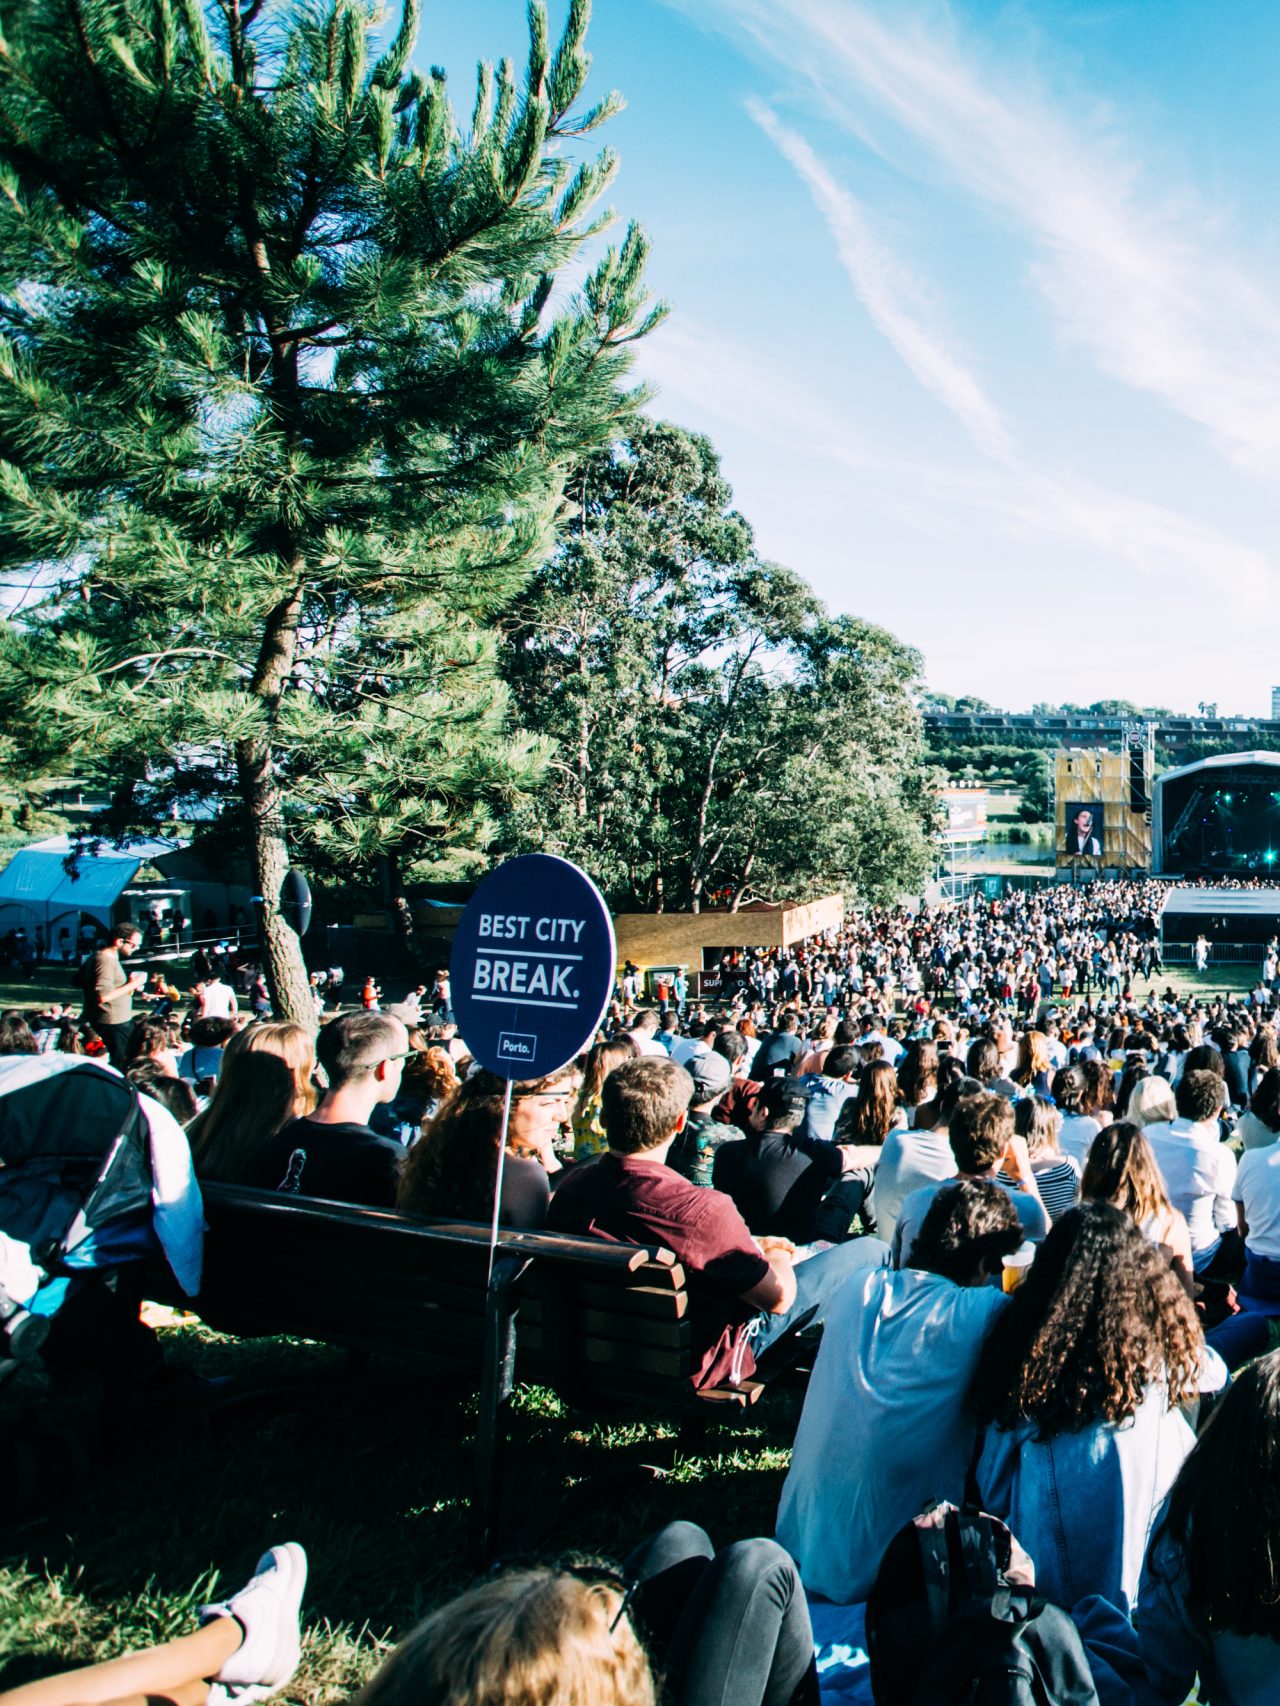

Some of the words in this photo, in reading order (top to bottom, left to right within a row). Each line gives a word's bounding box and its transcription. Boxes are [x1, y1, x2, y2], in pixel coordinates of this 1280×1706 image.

[478, 914, 531, 939] BEST
[535, 917, 587, 943] CITY
[472, 958, 580, 998] BREAK.
[502, 1040, 530, 1054] Porto.
